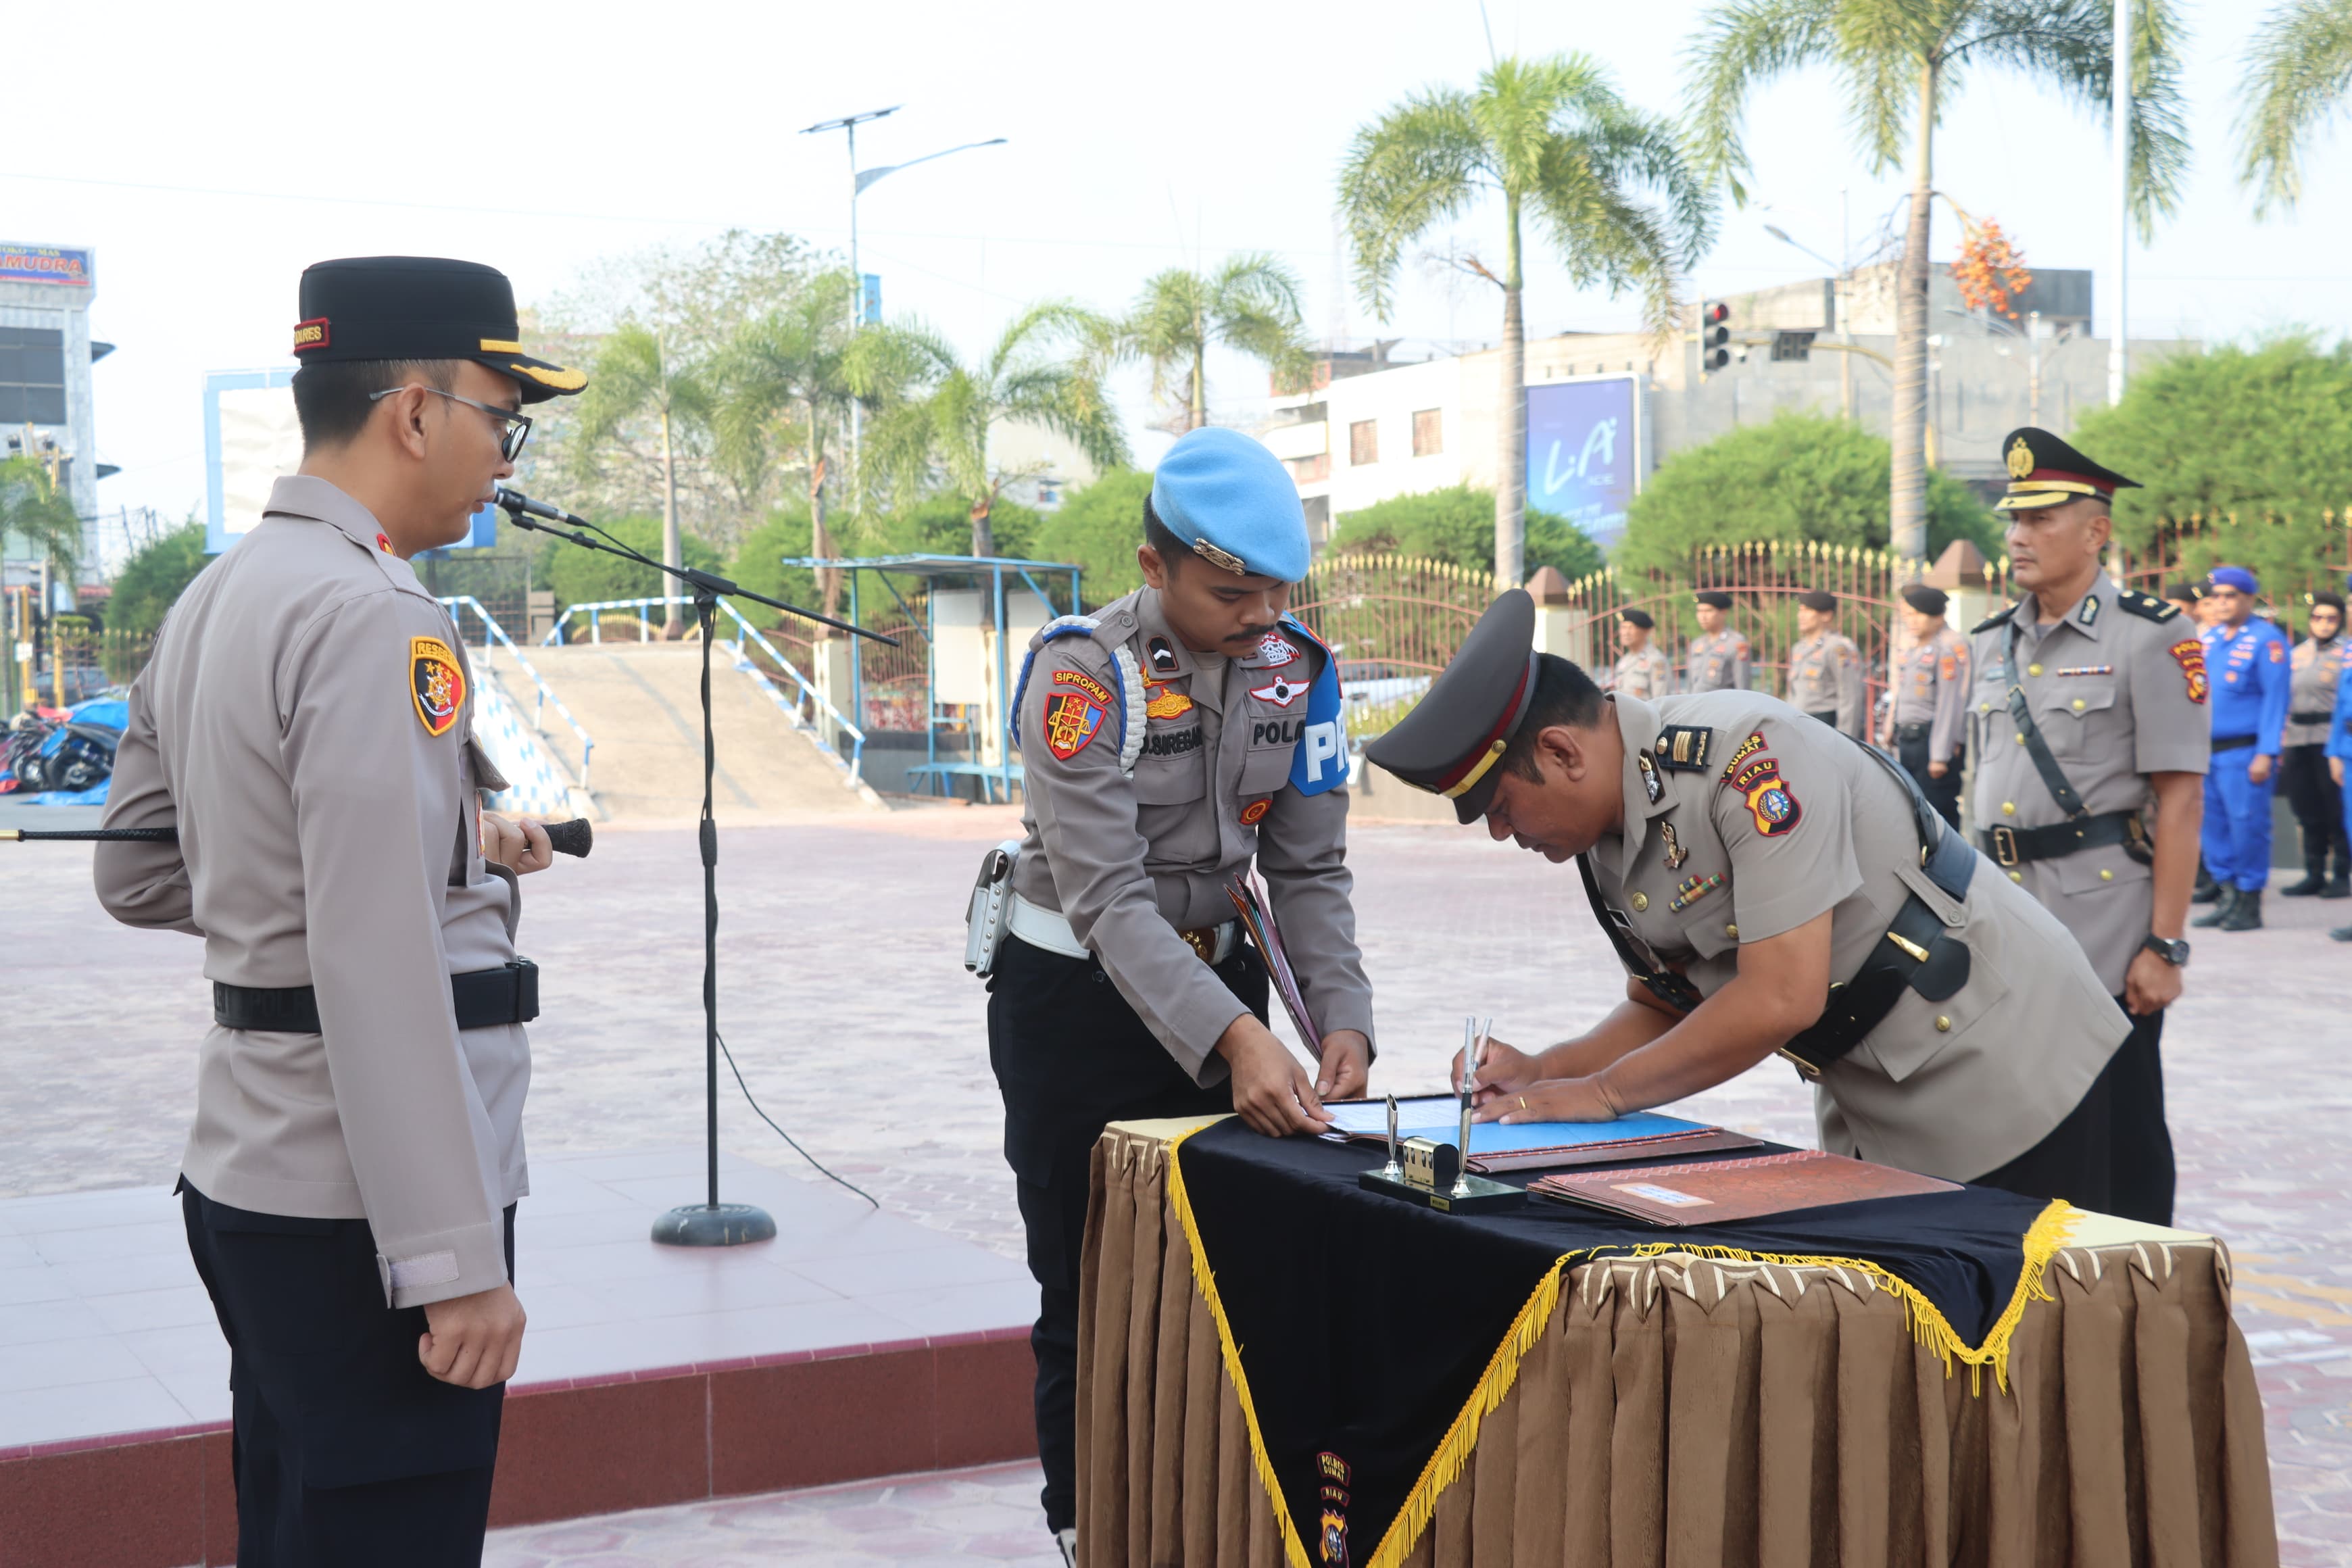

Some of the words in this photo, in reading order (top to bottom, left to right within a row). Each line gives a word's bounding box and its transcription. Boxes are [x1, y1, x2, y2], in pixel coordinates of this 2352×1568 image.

[0, 254, 82, 273] MUDRA
[1056, 672, 1108, 702] SIPROPAM
[1727, 743, 1760, 774] DUMAI
[1738, 762, 1772, 785] RIAU
[1321, 1454, 1345, 1474] POLRES
[1325, 1487, 1342, 1500] RIAU
